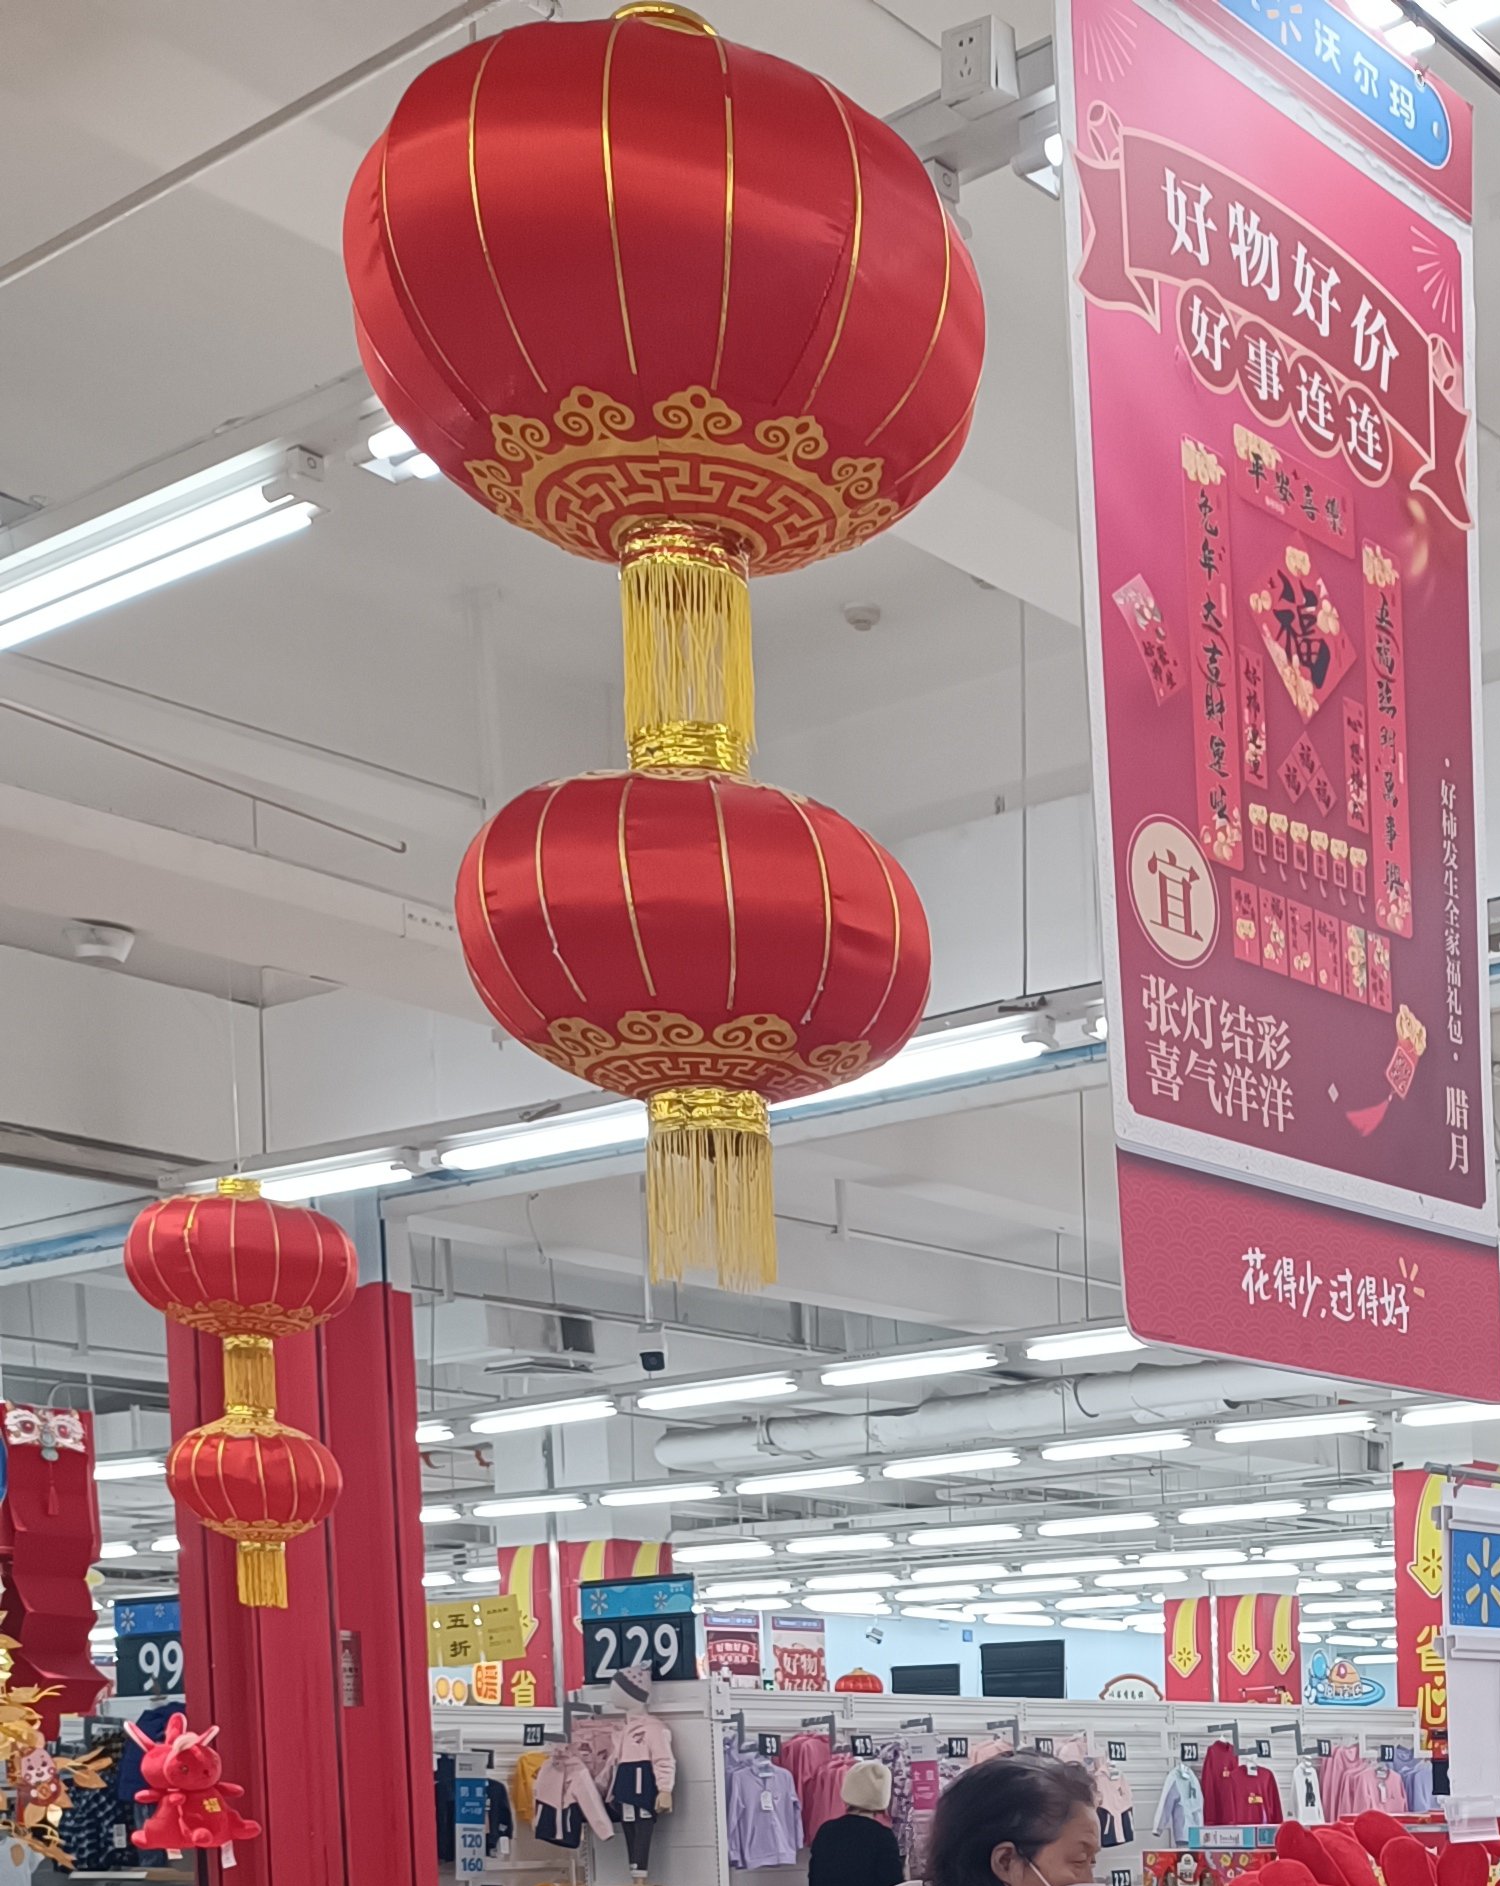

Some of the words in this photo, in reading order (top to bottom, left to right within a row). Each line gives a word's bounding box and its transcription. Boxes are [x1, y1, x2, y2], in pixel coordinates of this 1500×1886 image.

[1314, 18, 1415, 130] 沃尔玛
[1160, 166, 1401, 395] 好物好价
[1190, 296, 1385, 473] 好事连连
[1272, 568, 1331, 690] 福
[1148, 848, 1204, 942] 宜
[1140, 973, 1292, 1071] 张灯结彩
[1145, 1036, 1296, 1133] 喜气洋洋
[1446, 1085, 1471, 1175] 腊月
[138, 1640, 184, 1692] 99
[511, 1669, 537, 1706] 省
[594, 1623, 679, 1678] 229
[782, 1652, 819, 1676] 好物
[461, 1833, 483, 1849] 120
[461, 1857, 483, 1872] 160
